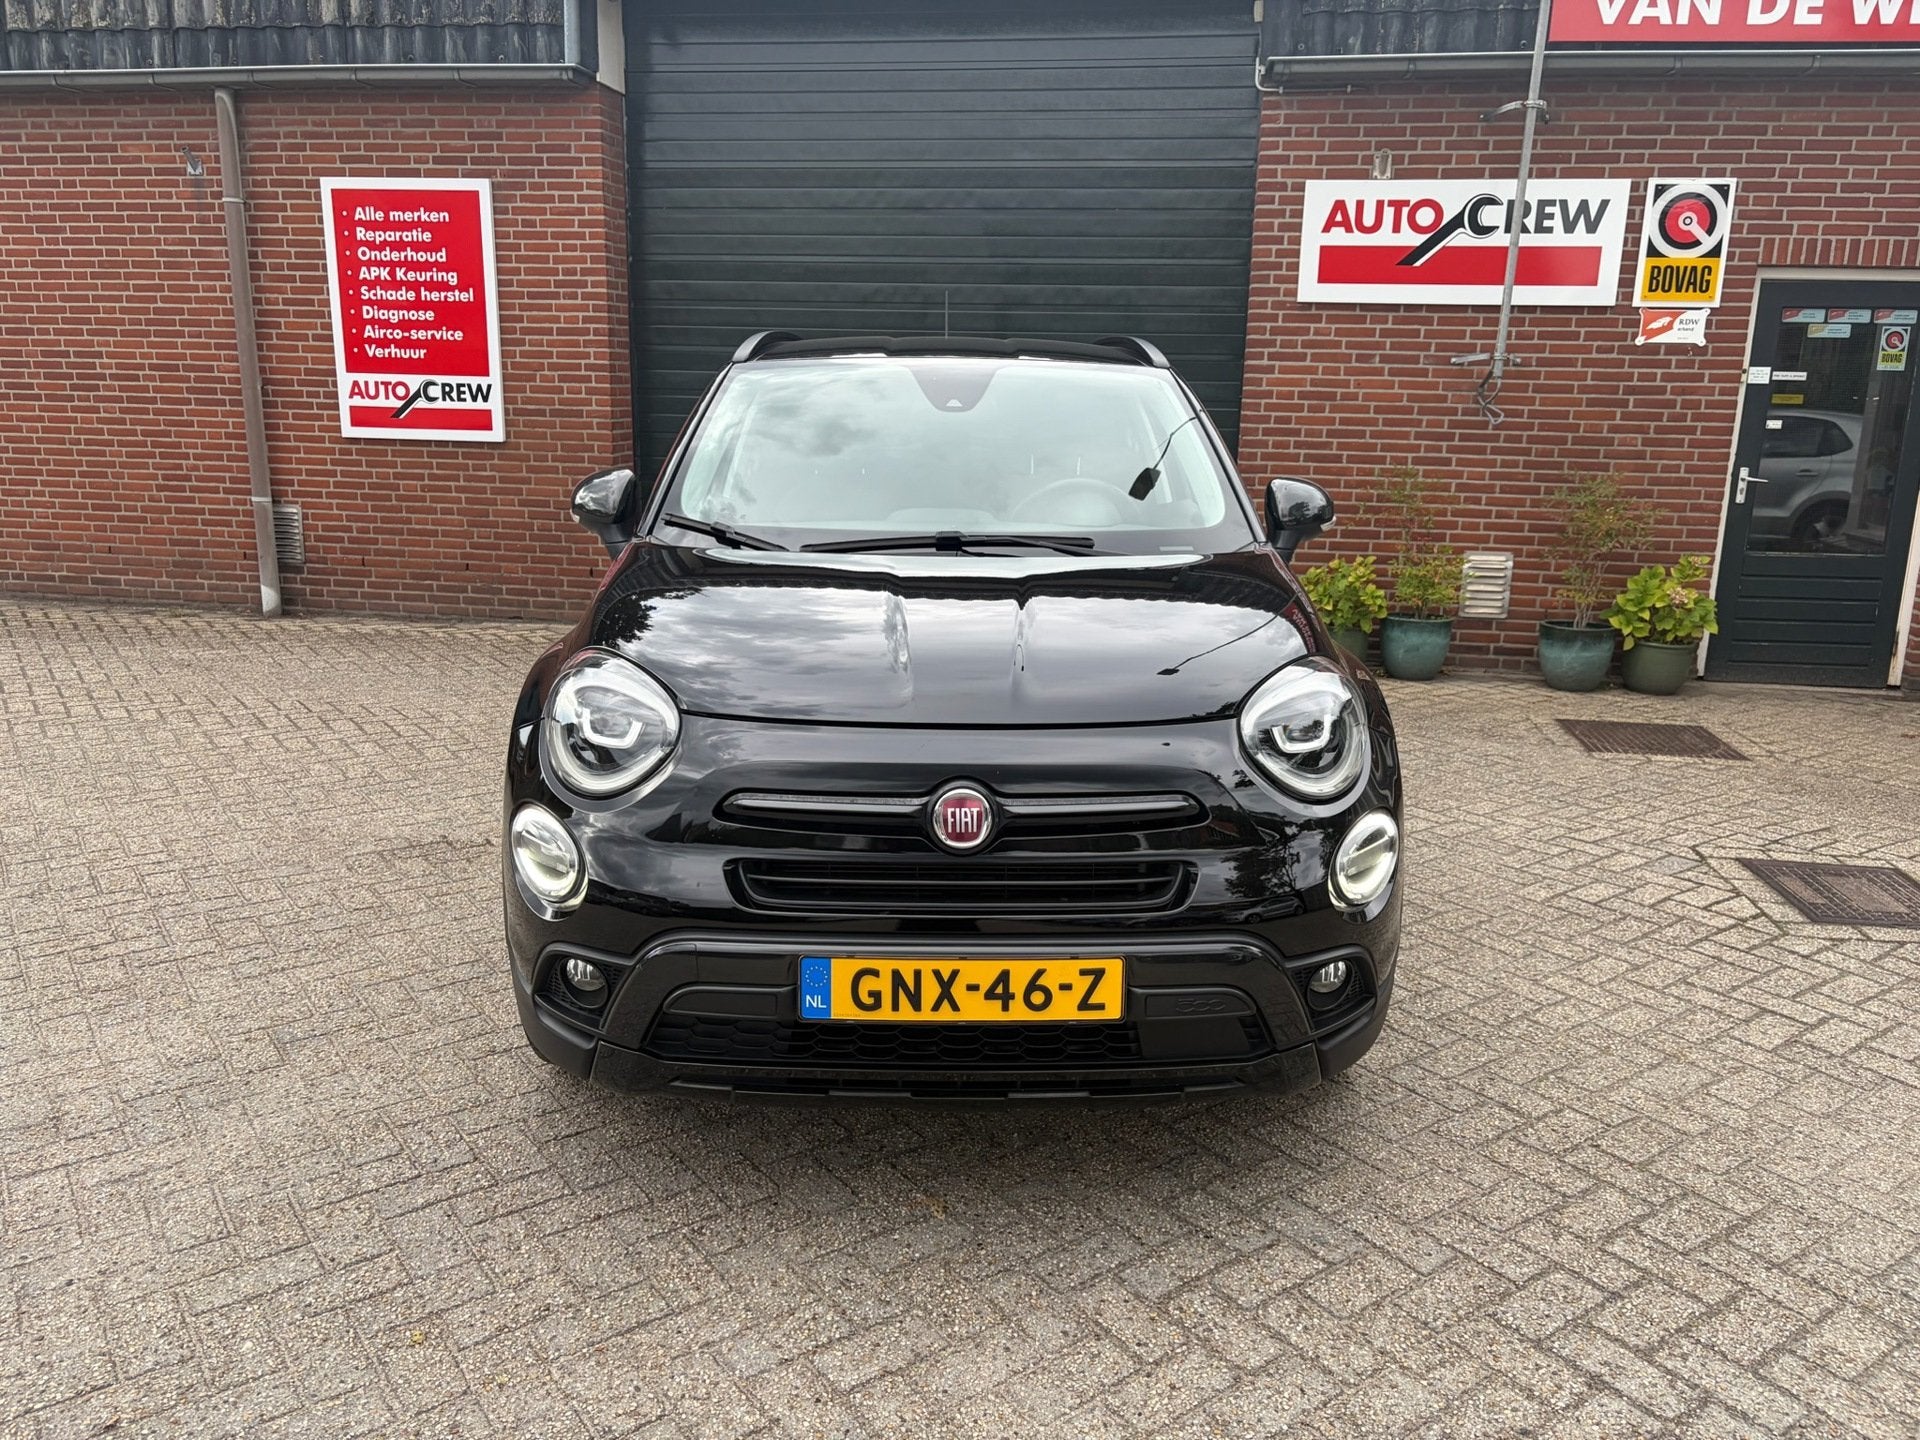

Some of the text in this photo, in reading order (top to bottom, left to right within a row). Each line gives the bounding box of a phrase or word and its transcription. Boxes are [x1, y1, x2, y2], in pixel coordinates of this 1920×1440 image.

[1597, 0, 1920, 25] VAN DE W
[354, 206, 449, 222] Alle merken
[1321, 195, 1611, 236] AUTO CREW
[355, 226, 432, 245] Reparatie
[357, 246, 447, 262] Onderhoud
[358, 266, 458, 286] APK Keuring
[1648, 265, 1713, 293] BOVAG
[360, 285, 474, 302] Schade herstel
[361, 305, 435, 323] Diagnose
[1678, 318, 1700, 326] RDW
[363, 325, 464, 341] Airco-service
[364, 343, 427, 359] Verhuur
[1881, 353, 1903, 363] BOVAG
[348, 380, 493, 403] AUTO CREW
[947, 807, 980, 833] FIAT
[805, 967, 1107, 1013] NL GNX-46-Z
